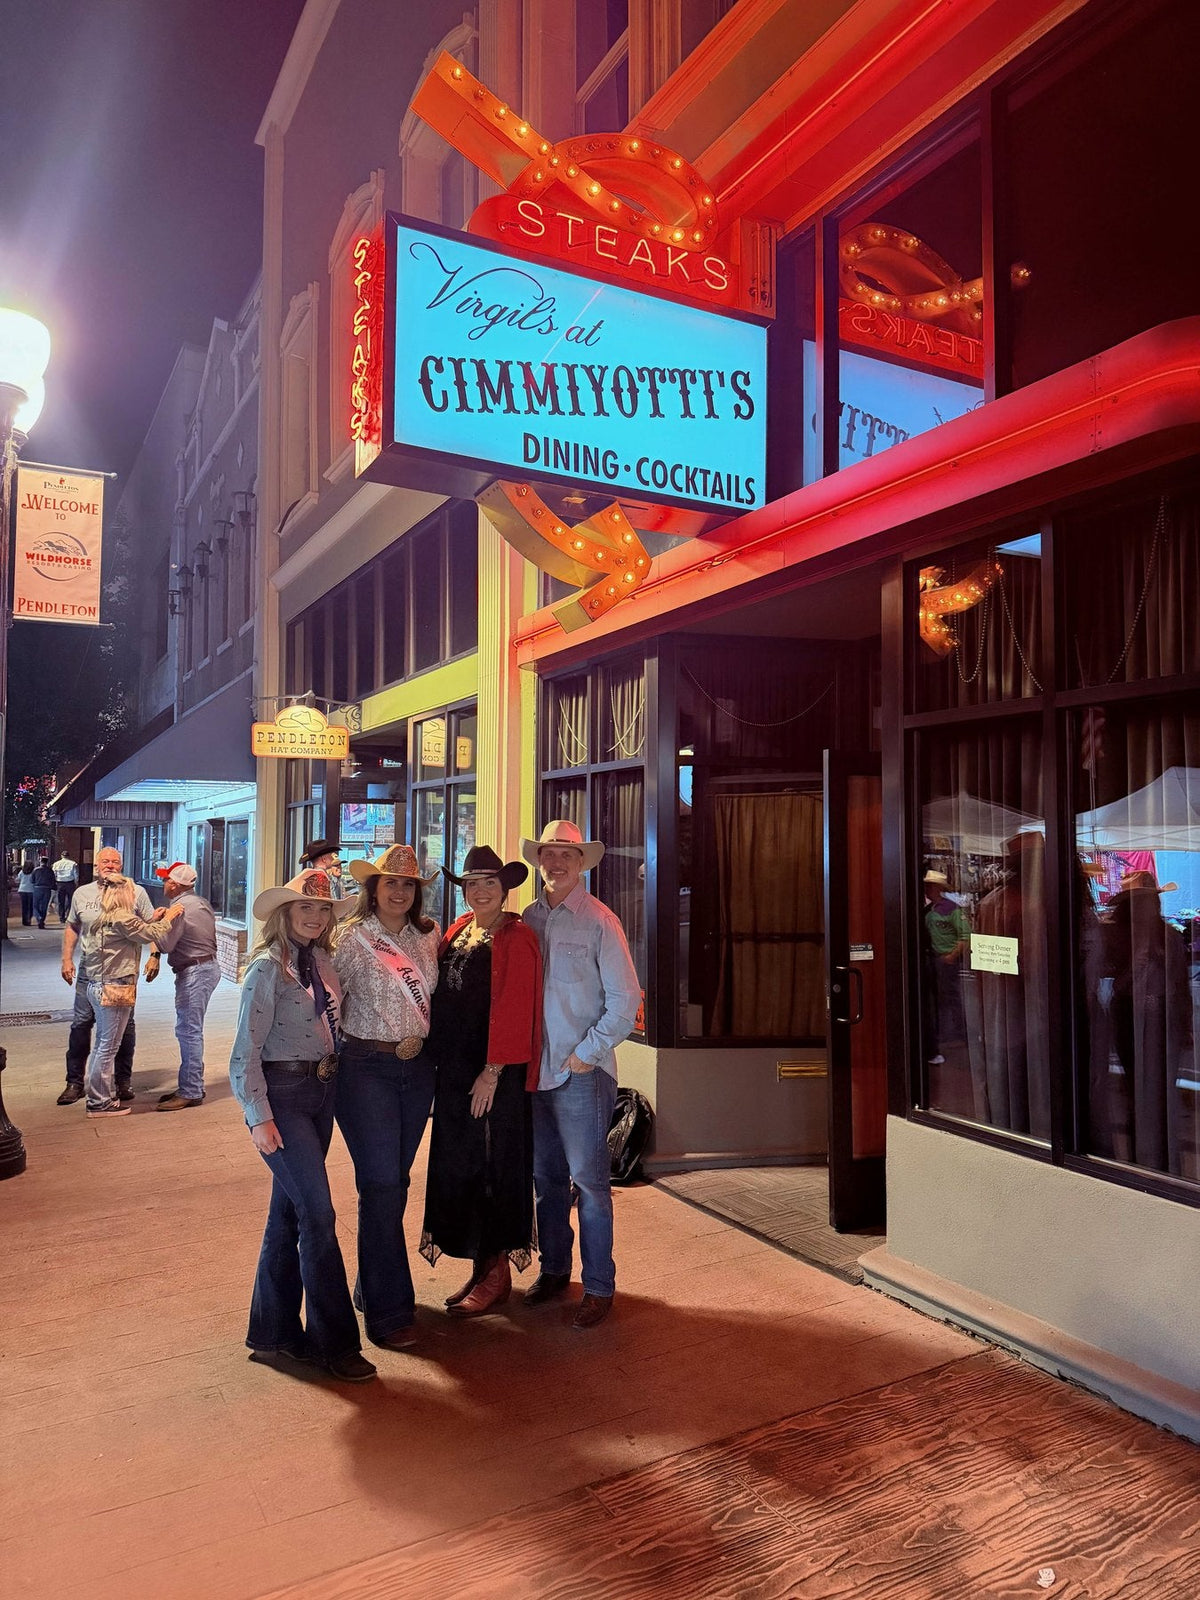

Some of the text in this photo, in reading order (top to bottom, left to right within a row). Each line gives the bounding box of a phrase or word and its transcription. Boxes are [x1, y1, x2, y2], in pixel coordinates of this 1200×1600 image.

[515, 199, 730, 291] STEAKS
[409, 241, 603, 348] Virgil's at
[418, 354, 756, 421] CIMMIYOTTI'S
[522, 432, 757, 506] DINING COCKTAILS
[21, 493, 99, 515] WELCOME
[55, 513, 66, 521] TO
[25, 552, 92, 566] WILDHORSE
[17, 597, 96, 617] PENDLETON
[256, 731, 346, 746] PENDLETON
[270, 746, 333, 755] HAT COMPANY
